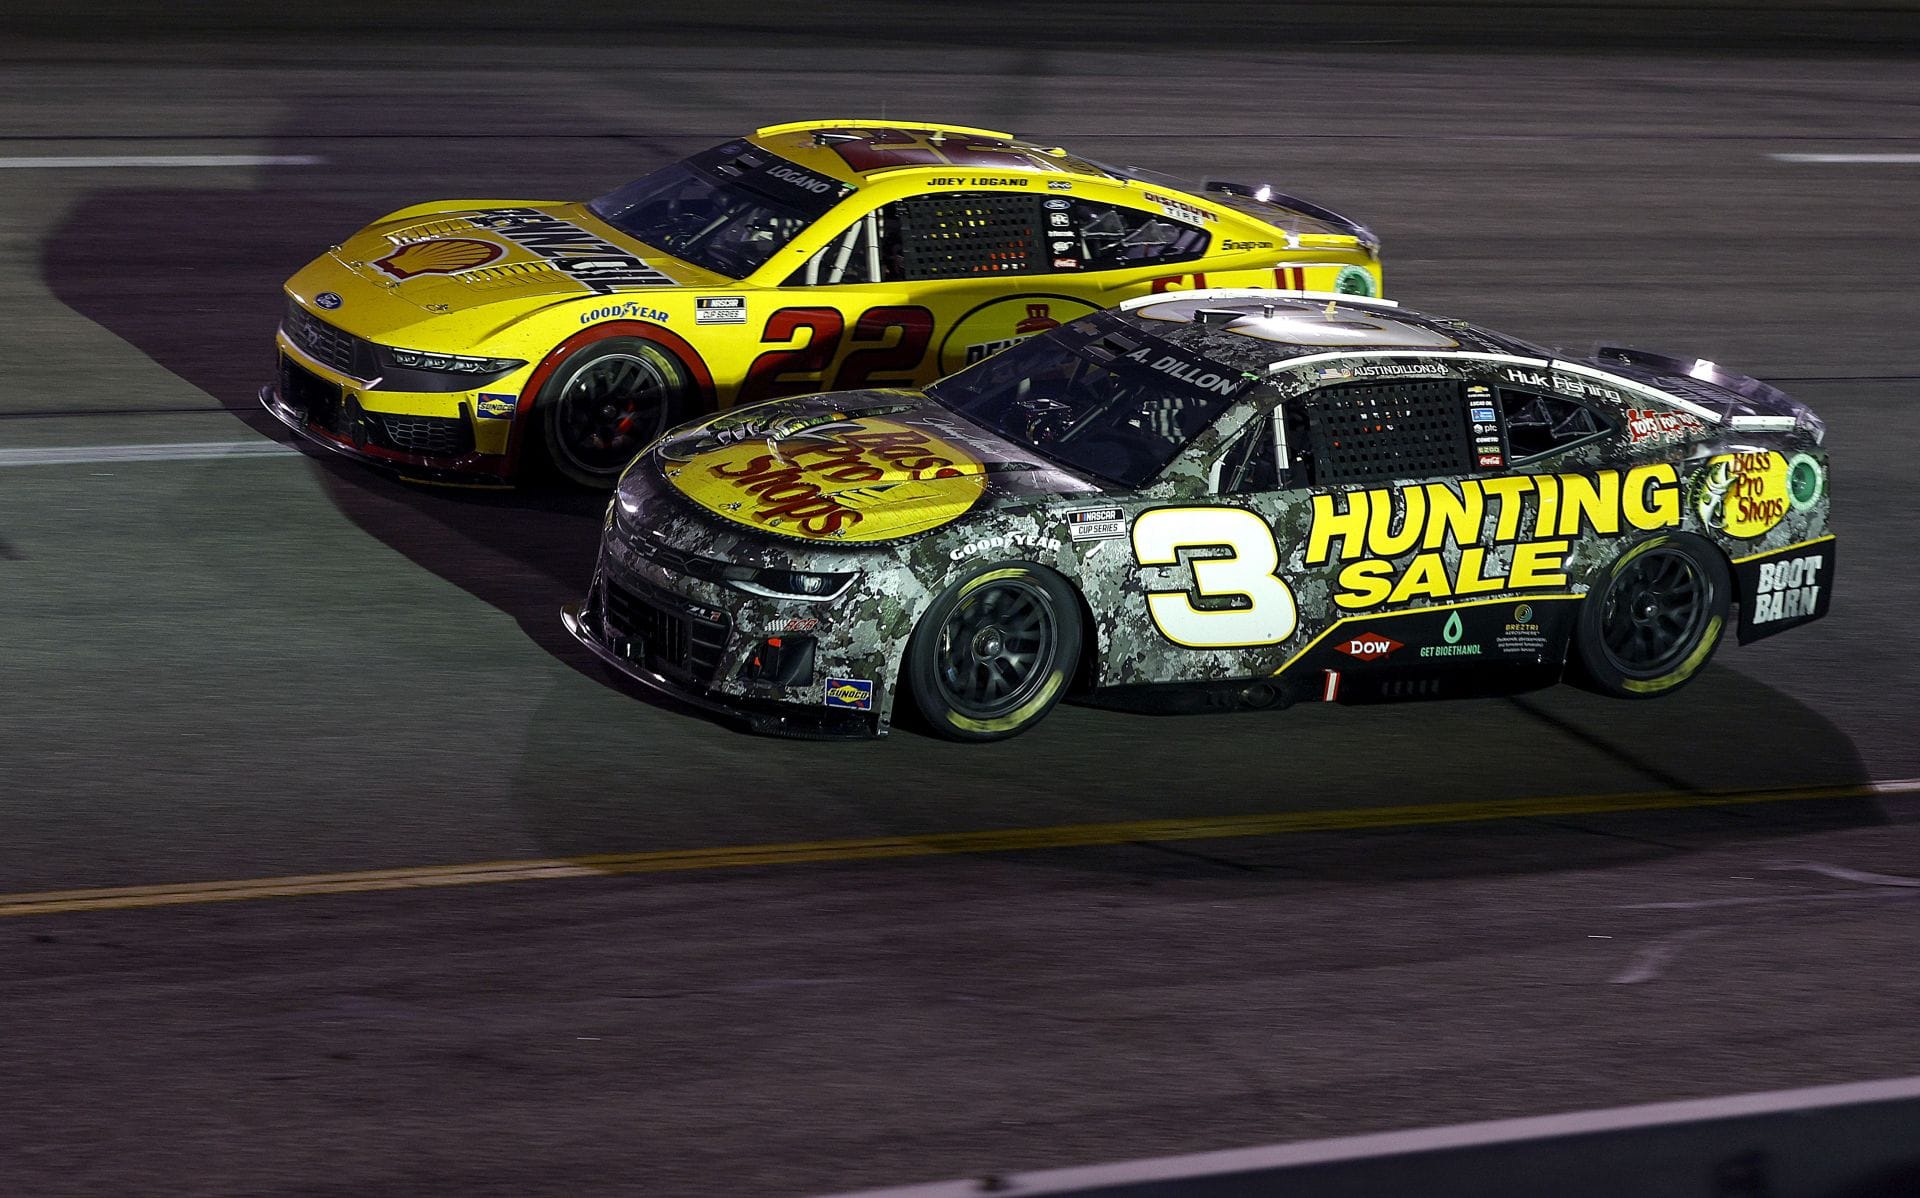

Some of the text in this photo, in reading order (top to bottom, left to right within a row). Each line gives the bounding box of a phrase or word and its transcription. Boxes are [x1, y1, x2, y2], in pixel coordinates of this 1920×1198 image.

[765, 165, 832, 194] LOGANO
[927, 177, 1028, 187] JOEY LOGANO
[1143, 191, 1219, 223] DISCOUNT
[1165, 206, 1201, 224] TIRE
[1221, 239, 1274, 252] Snap-on
[579, 302, 670, 325] GOODYEAR
[734, 304, 935, 406] 22
[1125, 346, 1239, 396] A. DILLON
[1507, 368, 1622, 404] Huk Fishing
[1631, 417, 1658, 435] TOYS
[1731, 450, 1771, 474] Bass
[709, 453, 864, 536] Shops
[1735, 472, 1764, 498] Pro
[1086, 511, 1116, 522] NASCAR
[1304, 462, 1682, 565] HUNTING
[1736, 496, 1784, 526] Shops
[1078, 523, 1119, 535] CUP SERIES
[949, 530, 1062, 561] GOODYEAR
[1132, 504, 1297, 647] 3
[1333, 540, 1570, 609] SALE
[1756, 555, 1824, 595] BOOT
[1752, 586, 1820, 625] BARN
[1419, 643, 1482, 658] GET BIOETHANOL
[828, 688, 869, 700] SUNOCO
